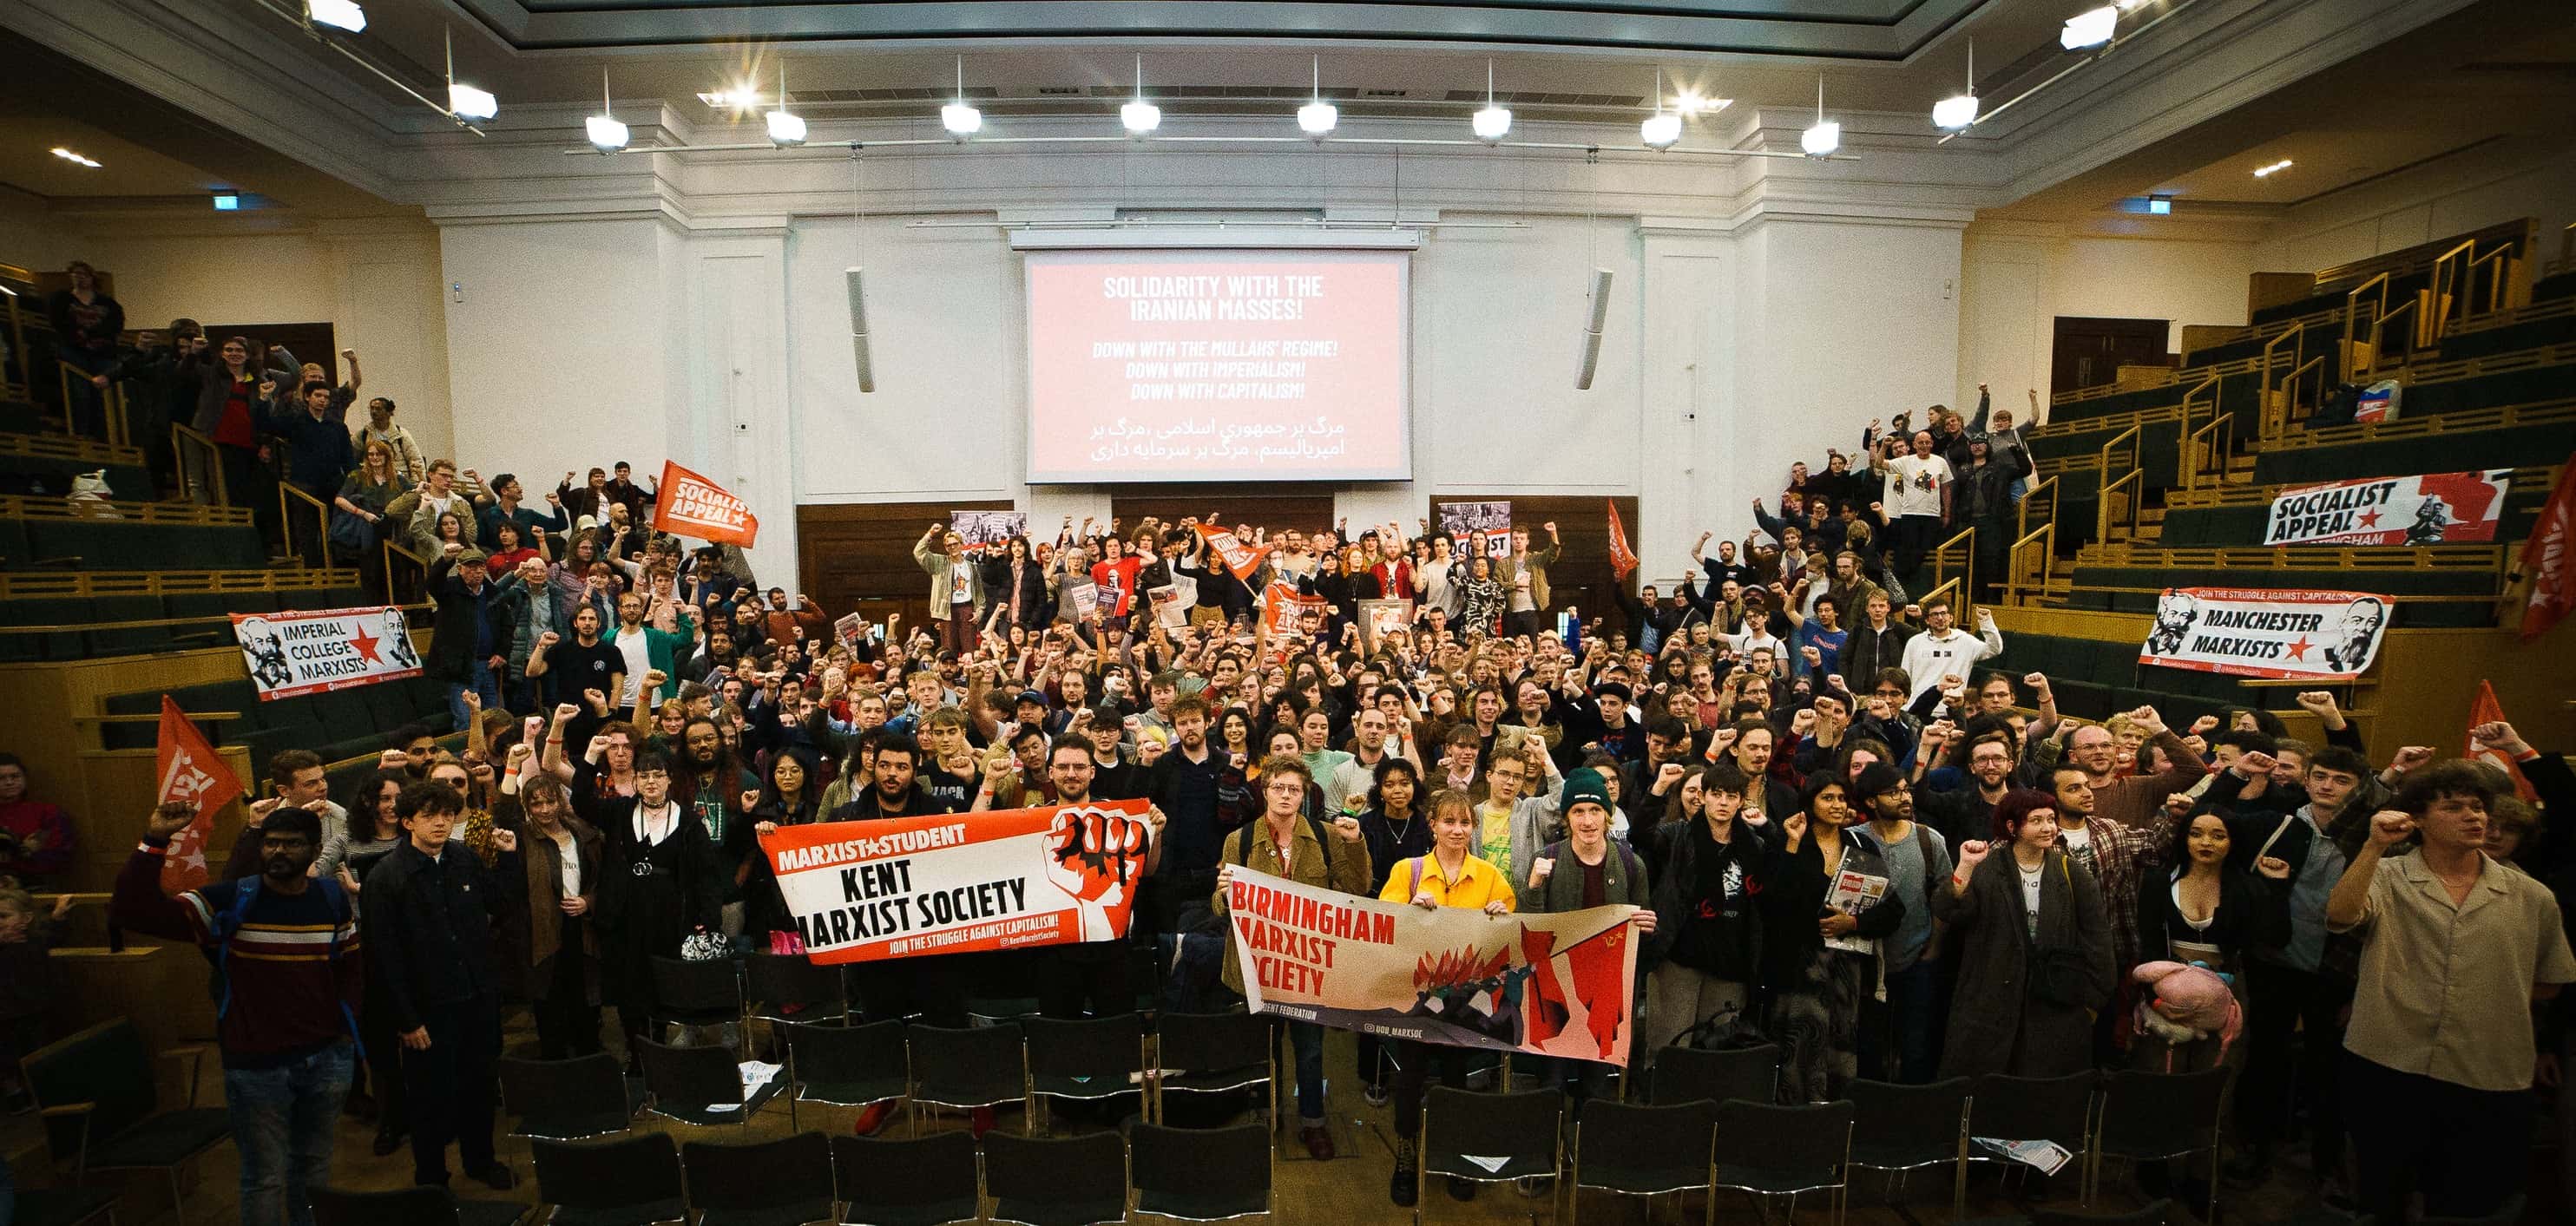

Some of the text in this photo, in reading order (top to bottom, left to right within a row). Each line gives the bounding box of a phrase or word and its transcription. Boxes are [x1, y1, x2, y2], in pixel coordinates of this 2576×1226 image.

[1104, 276, 1324, 298] SOLIDARITY WITH THE
[1130, 298, 1304, 322] IRANIAN MASSES!
[1092, 341, 1136, 358] DOWN
[1140, 341, 1175, 357] WITH
[1180, 340, 1209, 357] THE
[1281, 339, 1338, 357] REGIME!
[1125, 361, 1306, 378] DOWN WITH IMPERIALISM!
[1130, 382, 1306, 400] DOWN WITH CAPITALISM!
[1089, 425, 1105, 440] بر
[1291, 424, 1305, 438] بر
[1308, 416, 1344, 438] مرگ
[1193, 444, 1208, 460] بر
[1212, 435, 1250, 459] مرگ
[670, 498, 731, 523] APPEAL
[675, 482, 752, 515] SOCIALIS
[2276, 482, 2397, 520] SOCIALIST
[2270, 510, 2354, 542] APPEAL
[2197, 589, 2213, 598] JOIN
[2214, 590, 2229, 599] THE
[2229, 590, 2266, 600] STRUGGLE
[2267, 592, 2300, 600] AGAINST
[283, 621, 346, 641] IMPERIAL
[2203, 609, 2323, 633] MANCHESTER
[291, 640, 352, 660] COLLEGE
[2191, 634, 2284, 659] MARXISTS
[298, 657, 368, 681] MARXISTS
[778, 823, 966, 872] MARXIST STUDENT
[839, 859, 911, 903] KENT
[917, 877, 1026, 929] SOCIETY
[1232, 881, 1395, 946] BIRMINGHAM
[889, 914, 1060, 954] JOIN THE STRUGGLE AGAINST CAPITALISM!
[1252, 954, 1324, 997] CIETY
[1279, 1005, 1318, 1021] FEDERATION
